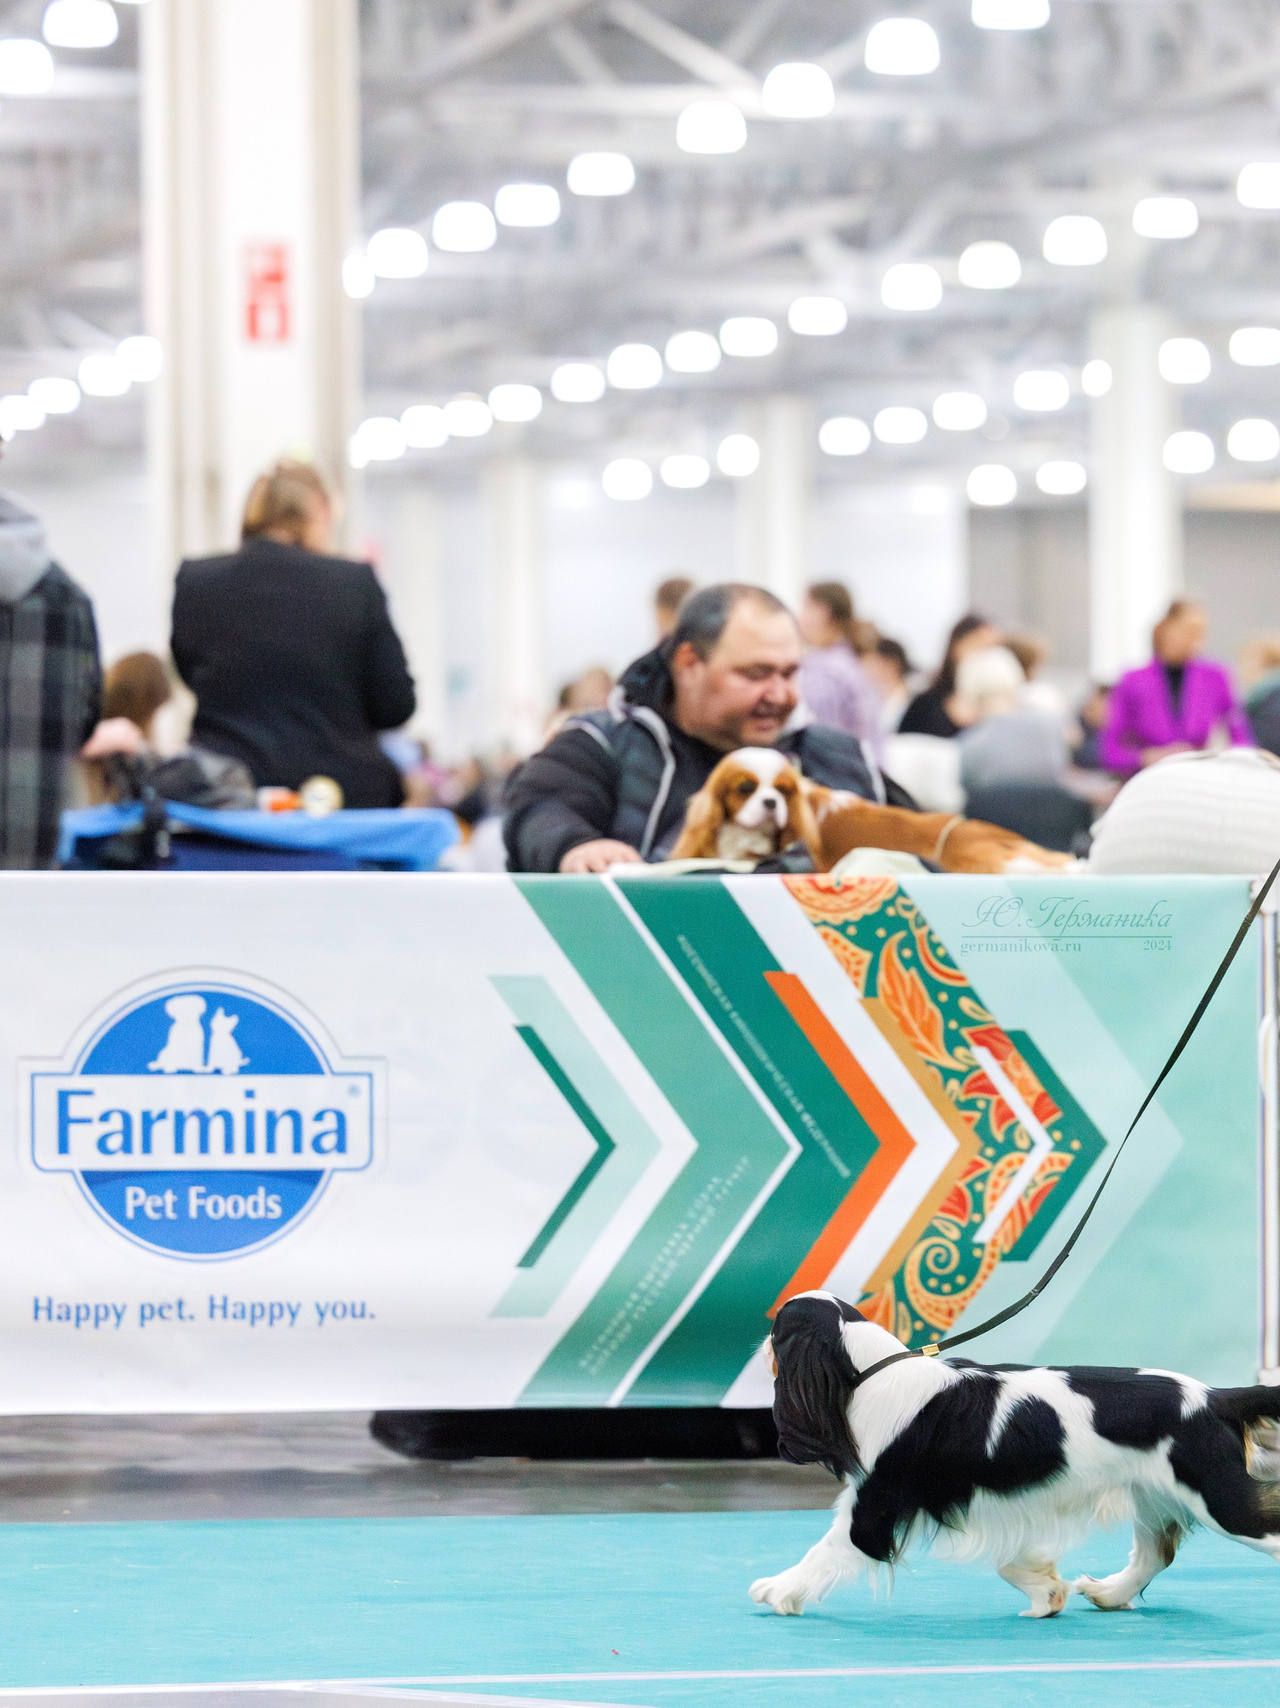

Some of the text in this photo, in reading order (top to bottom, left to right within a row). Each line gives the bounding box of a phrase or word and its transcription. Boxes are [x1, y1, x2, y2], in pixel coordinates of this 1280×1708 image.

[57, 1089, 348, 1156] Farmina
[125, 1185, 283, 1220] Pet Foods
[32, 1294, 377, 1330] Happy pet. Happy you.
